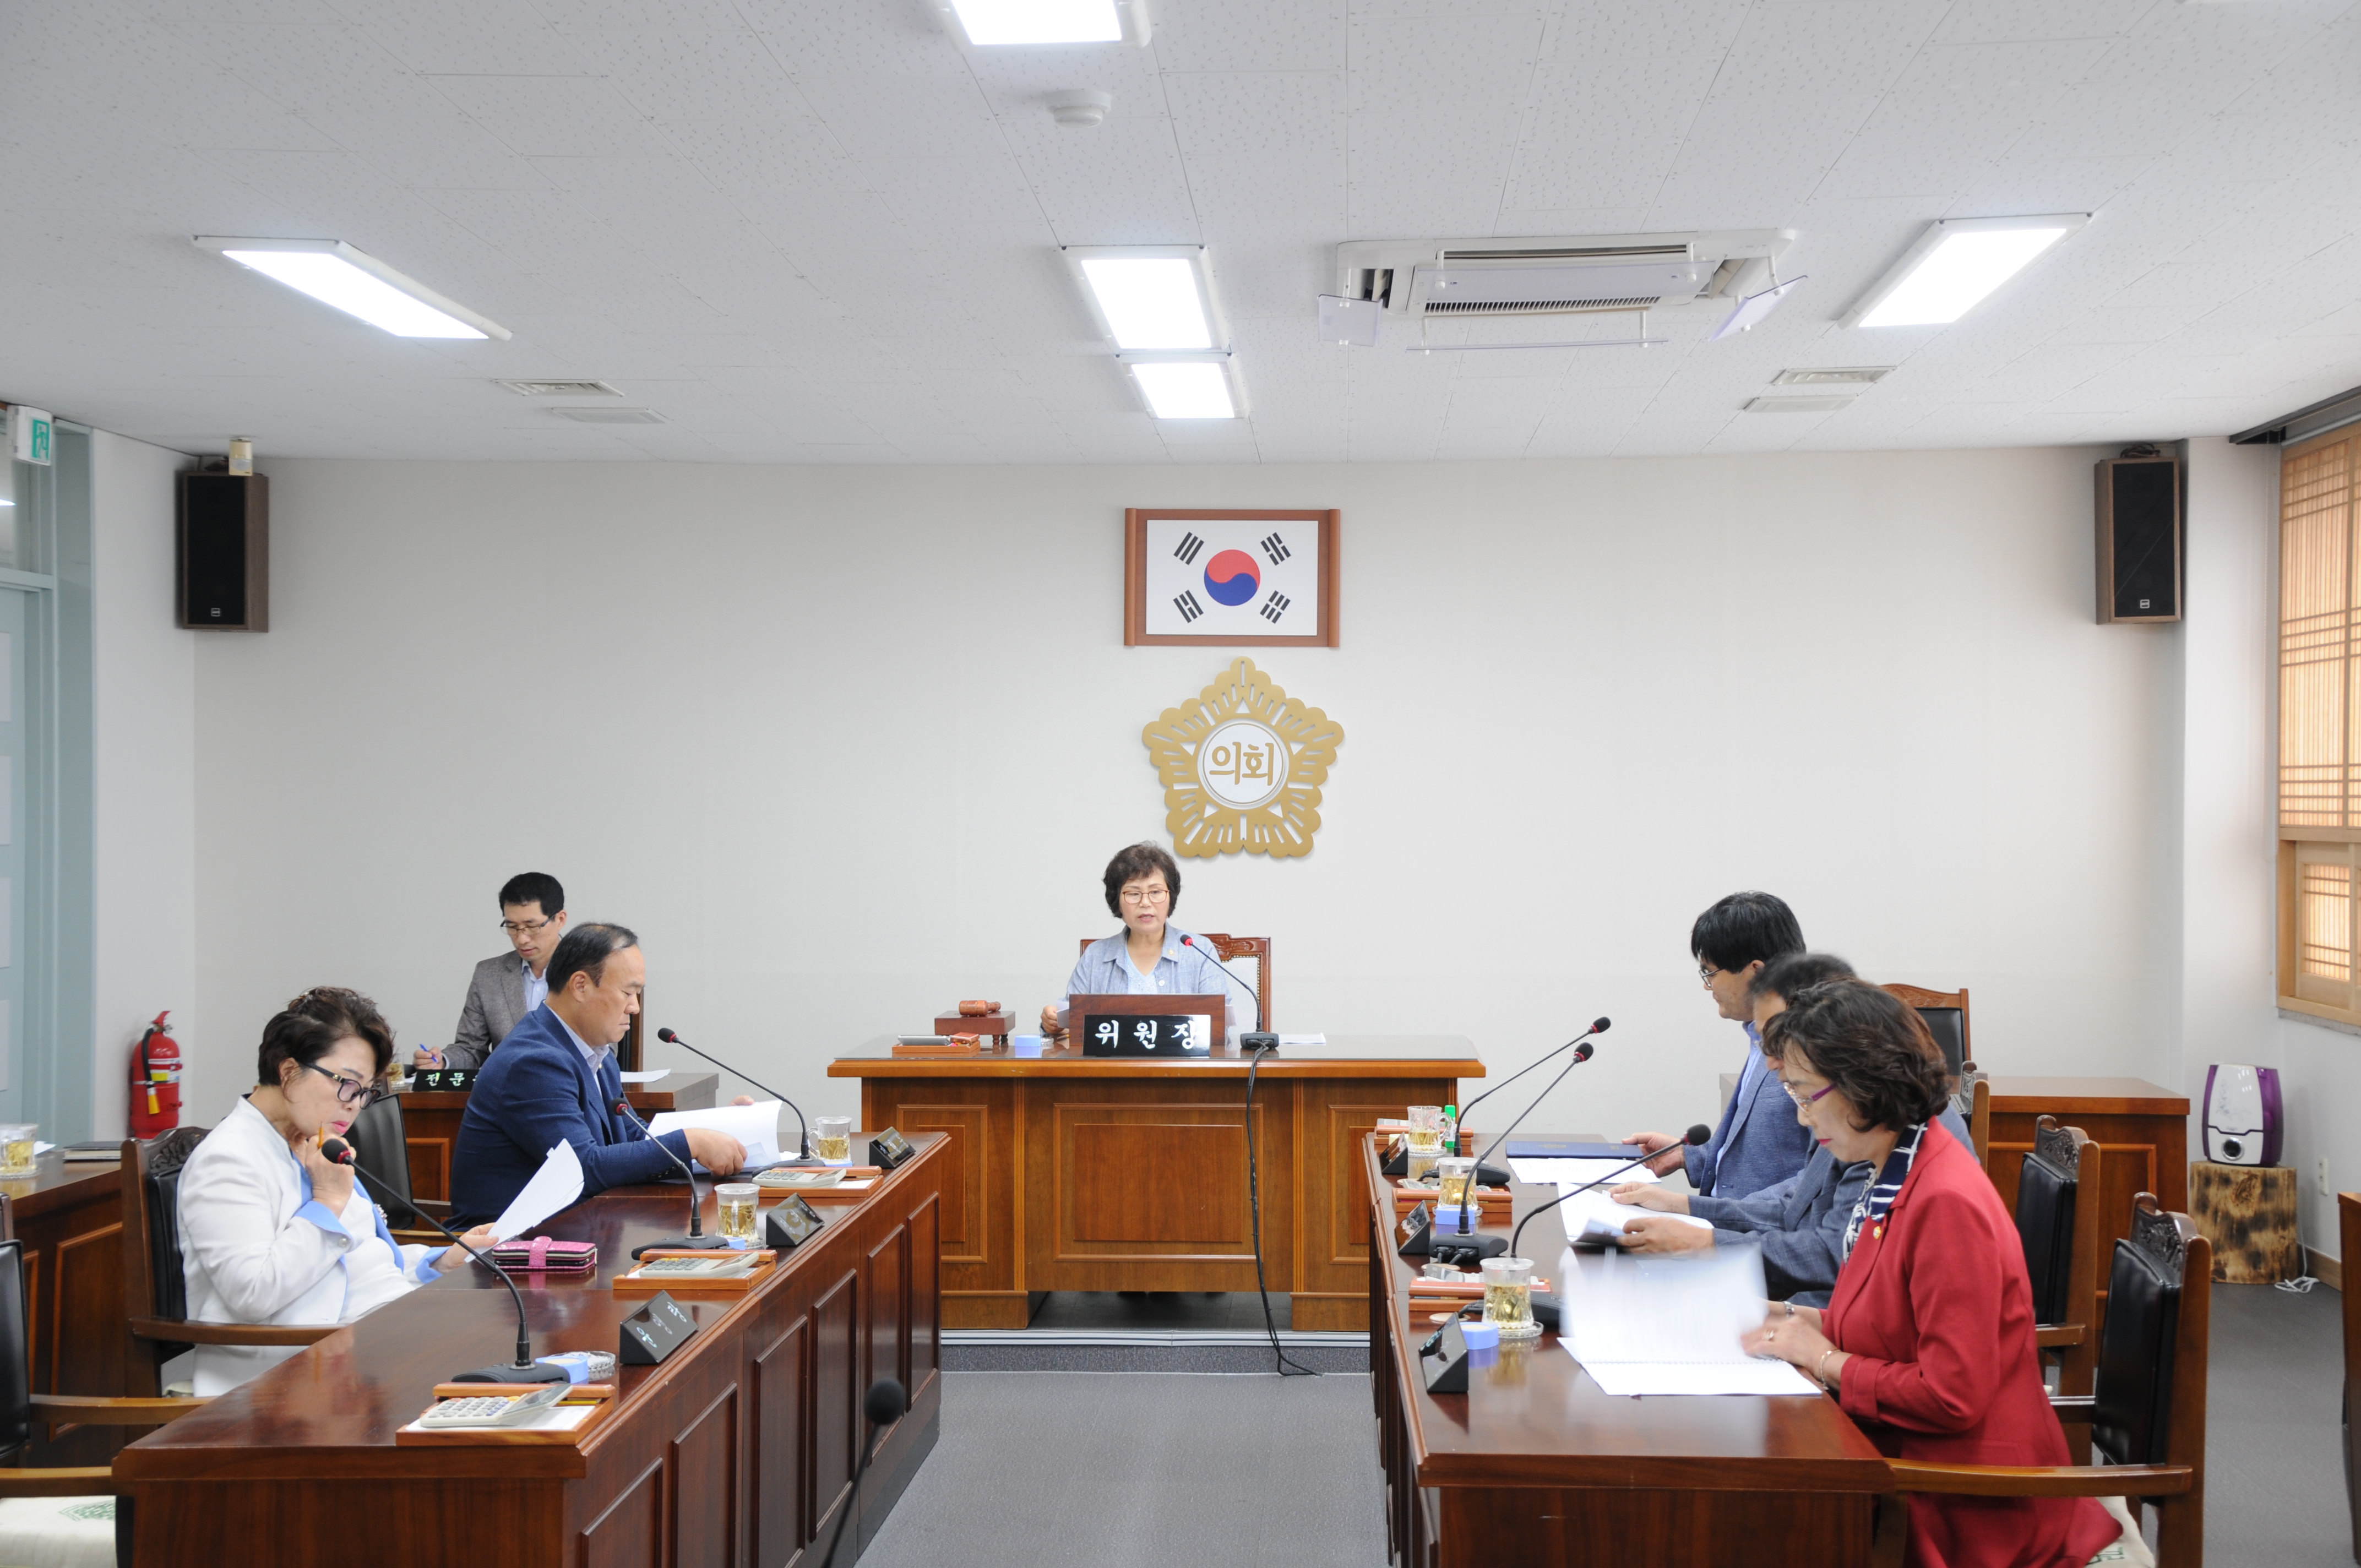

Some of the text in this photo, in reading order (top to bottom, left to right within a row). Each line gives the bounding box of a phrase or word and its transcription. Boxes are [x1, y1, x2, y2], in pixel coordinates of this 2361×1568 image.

[1209, 742, 1274, 786] 의회
[1095, 1020, 1199, 1049] 위원장
[425, 1072, 477, 1086] 전문
